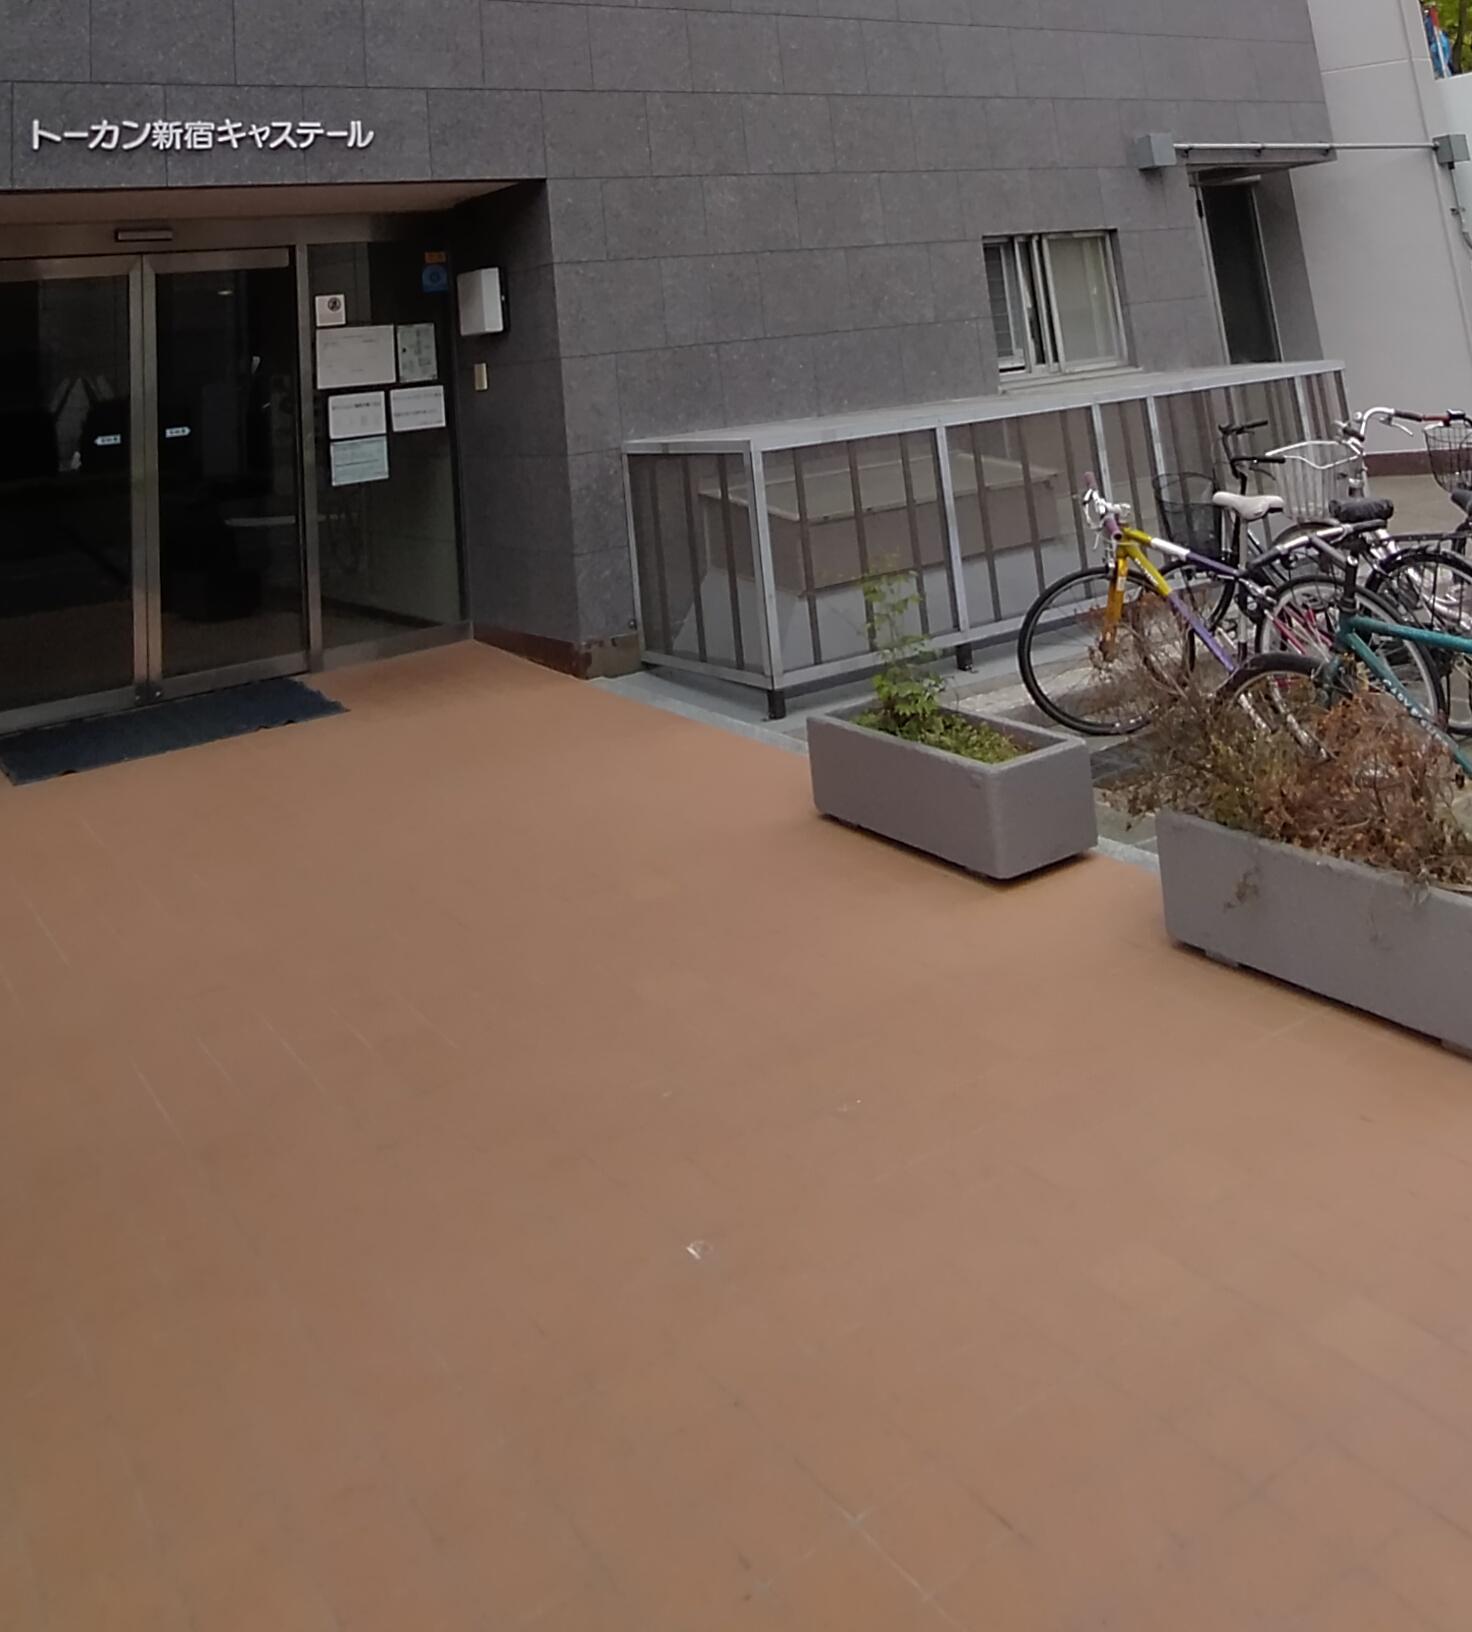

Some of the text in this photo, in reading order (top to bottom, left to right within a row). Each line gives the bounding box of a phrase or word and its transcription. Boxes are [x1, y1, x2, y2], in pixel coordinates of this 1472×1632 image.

[32, 118, 375, 150] トーカン新宿キャステール
